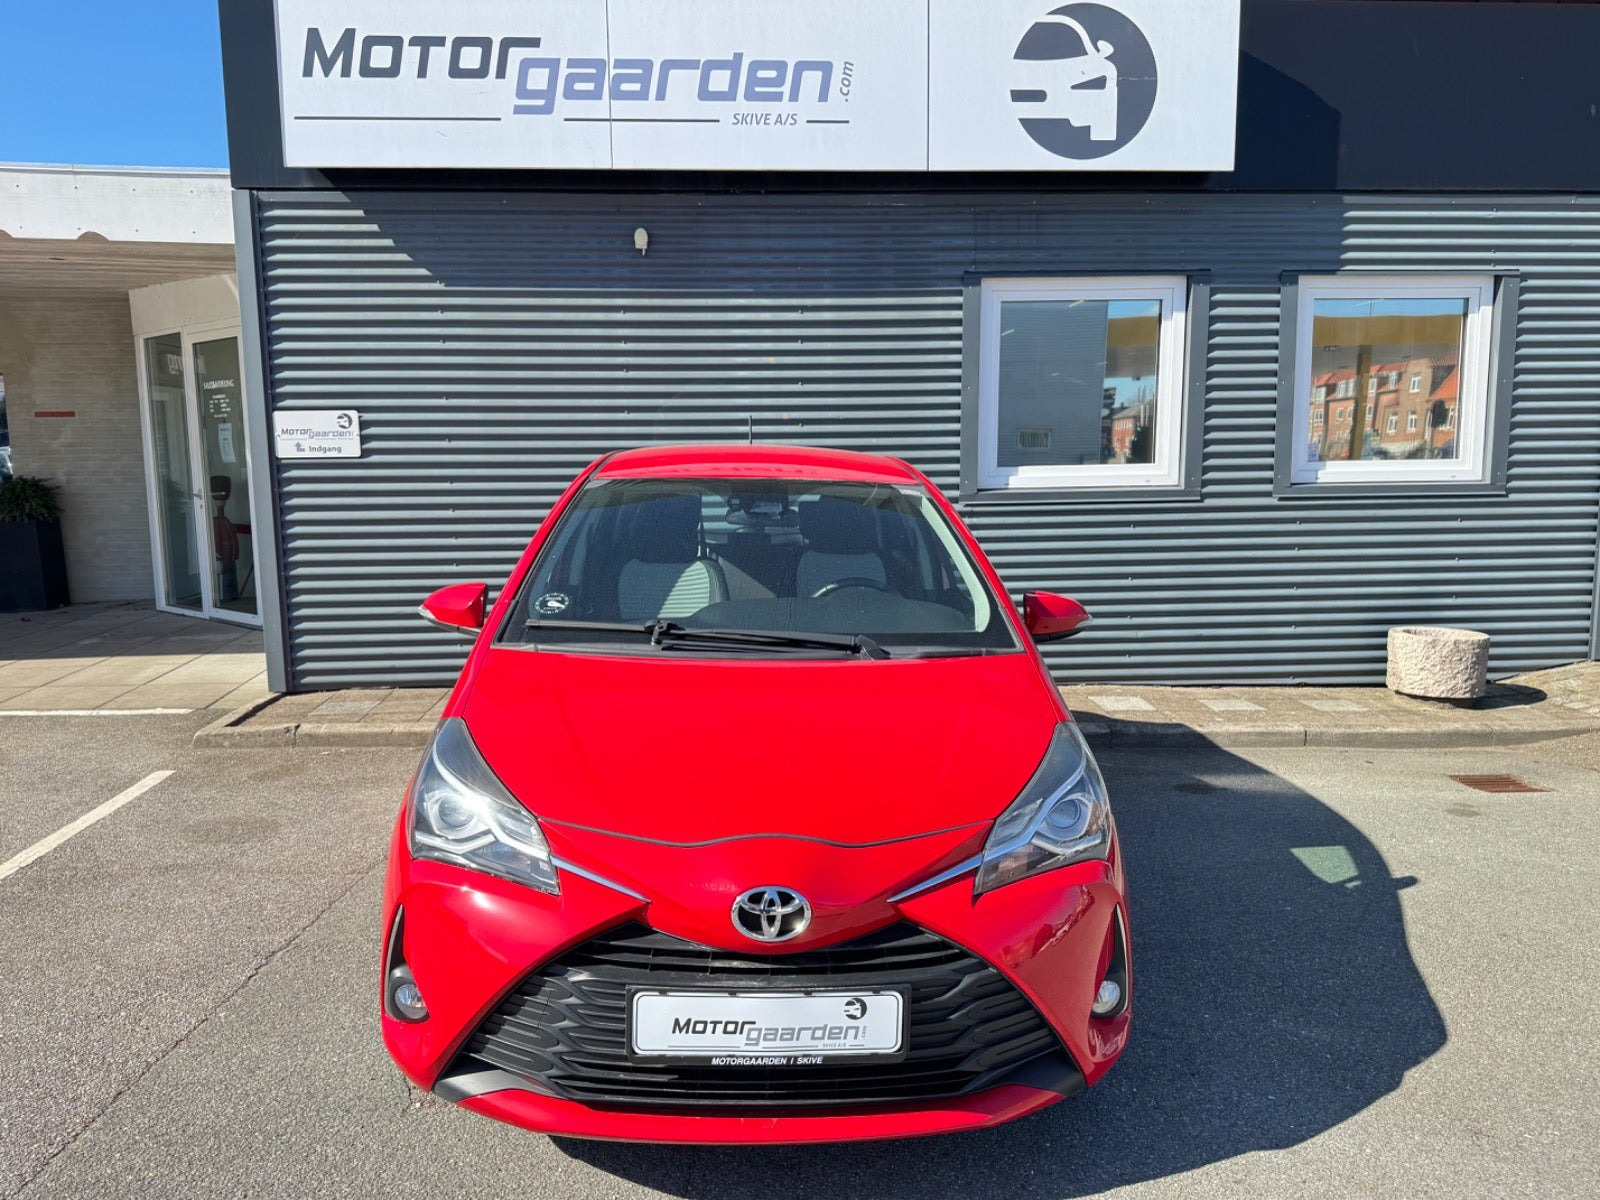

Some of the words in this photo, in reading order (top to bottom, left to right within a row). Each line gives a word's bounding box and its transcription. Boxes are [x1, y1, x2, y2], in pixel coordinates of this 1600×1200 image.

[731, 112, 771, 127] SKIVE
[774, 112, 798, 127] A/S
[308, 445, 342, 454] Indgang
[711, 1057, 787, 1065] MOTORGAARDEN
[796, 1056, 823, 1064] SKIVE
